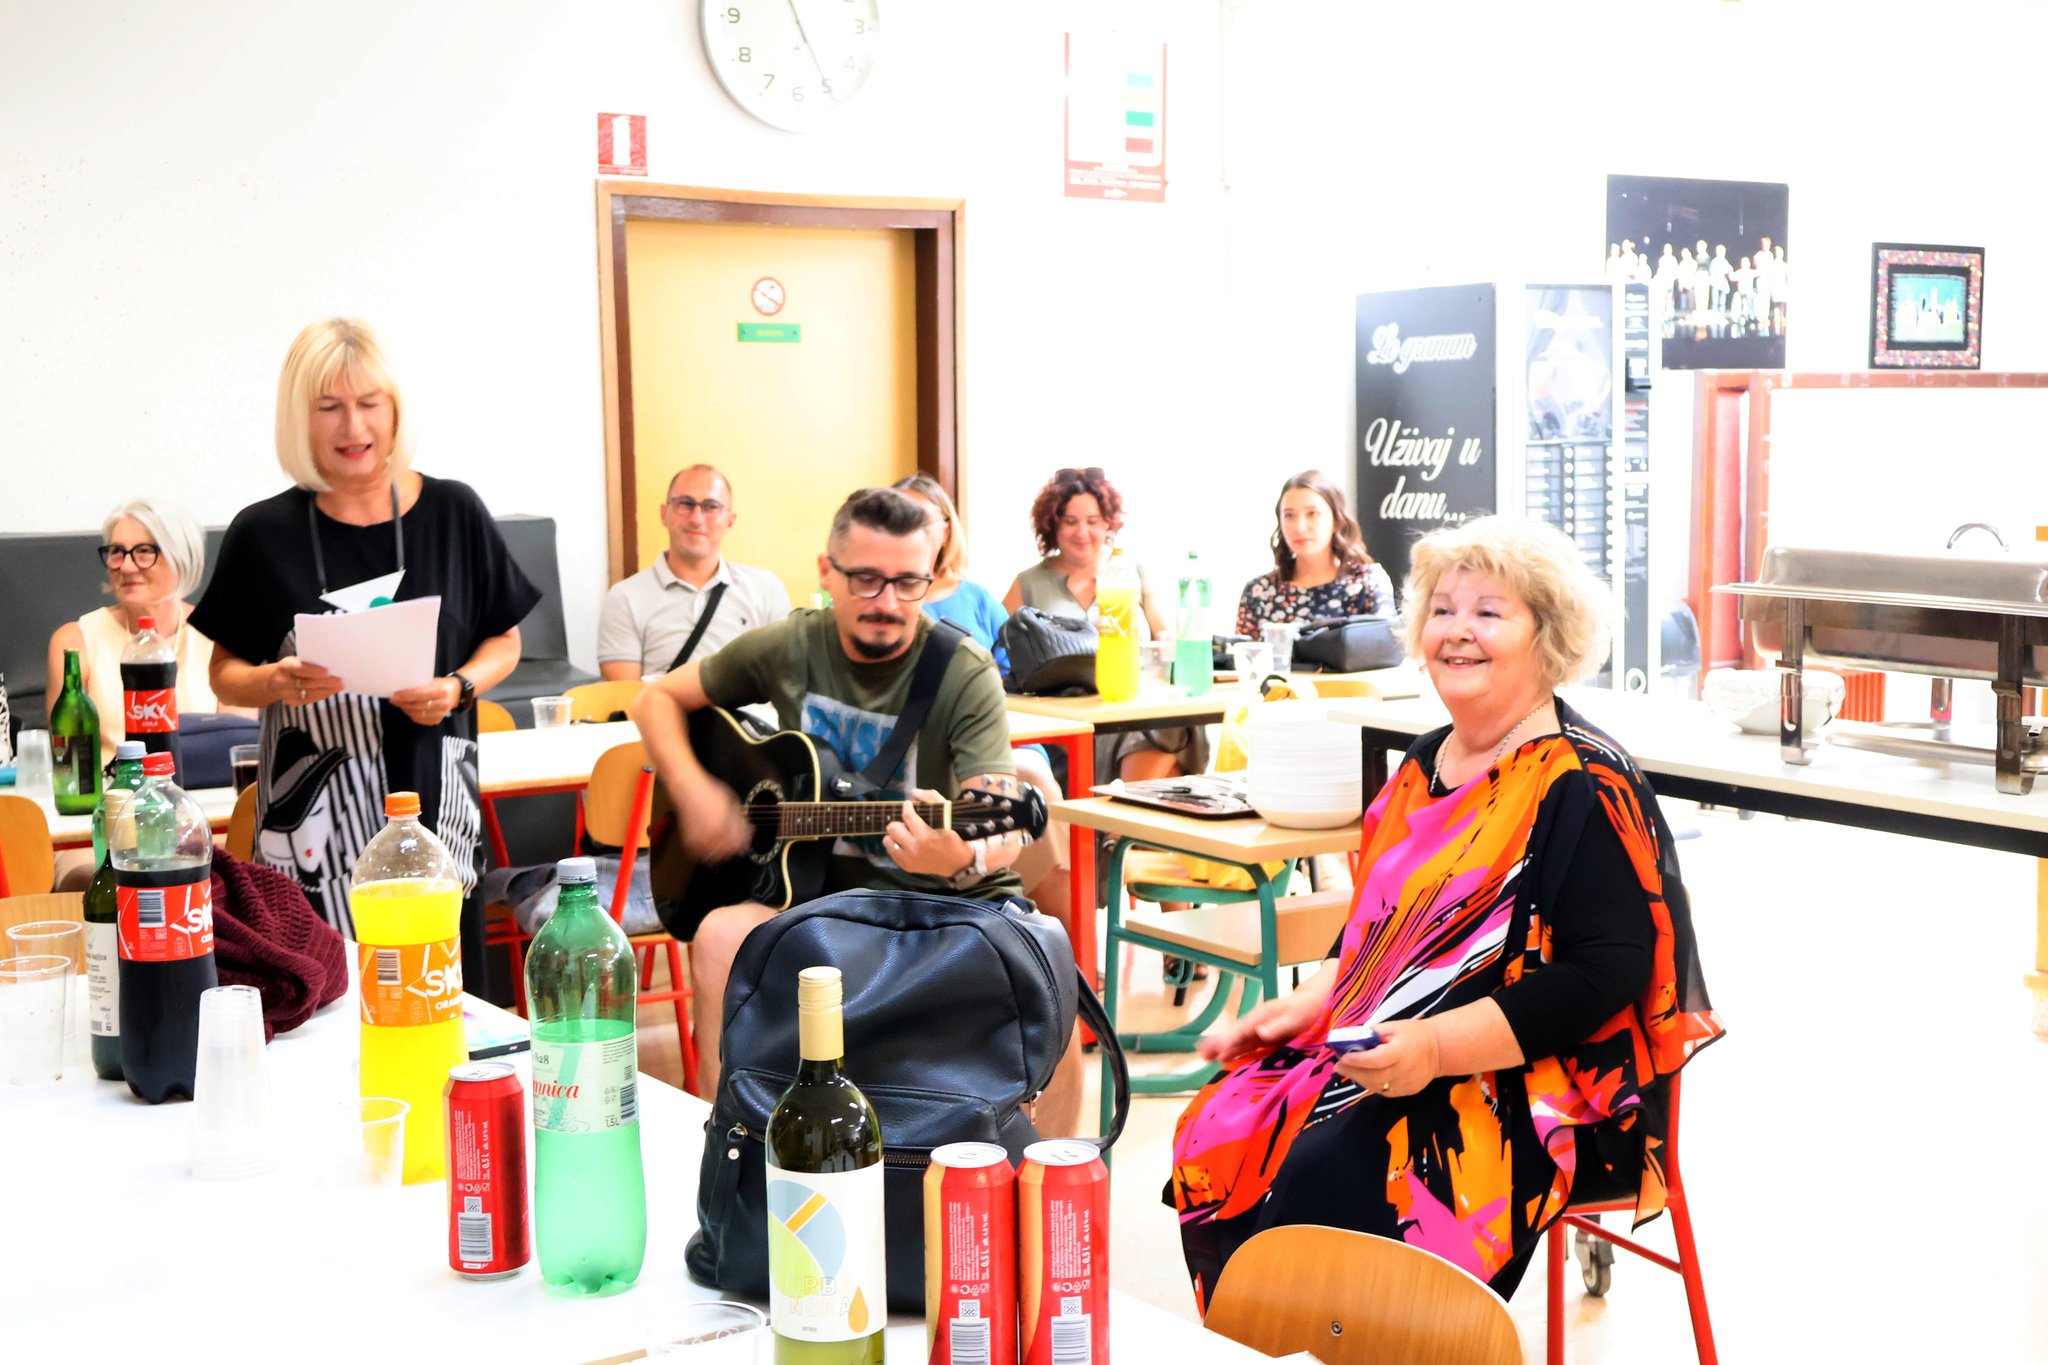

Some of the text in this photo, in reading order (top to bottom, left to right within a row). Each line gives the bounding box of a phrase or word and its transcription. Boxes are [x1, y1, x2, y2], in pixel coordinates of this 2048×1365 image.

[727, 7, 741, 24] 9
[855, 19, 865, 34] 3
[738, 46, 752, 63] 8
[843, 56, 855, 69] 4
[763, 74, 775, 89] 7
[821, 77, 833, 95] 5
[792, 87, 804, 102] 6
[1365, 417, 1482, 481] Uživaj u
[128, 702, 167, 720] SKY
[187, 899, 213, 933] SK
[425, 959, 463, 997] SK
